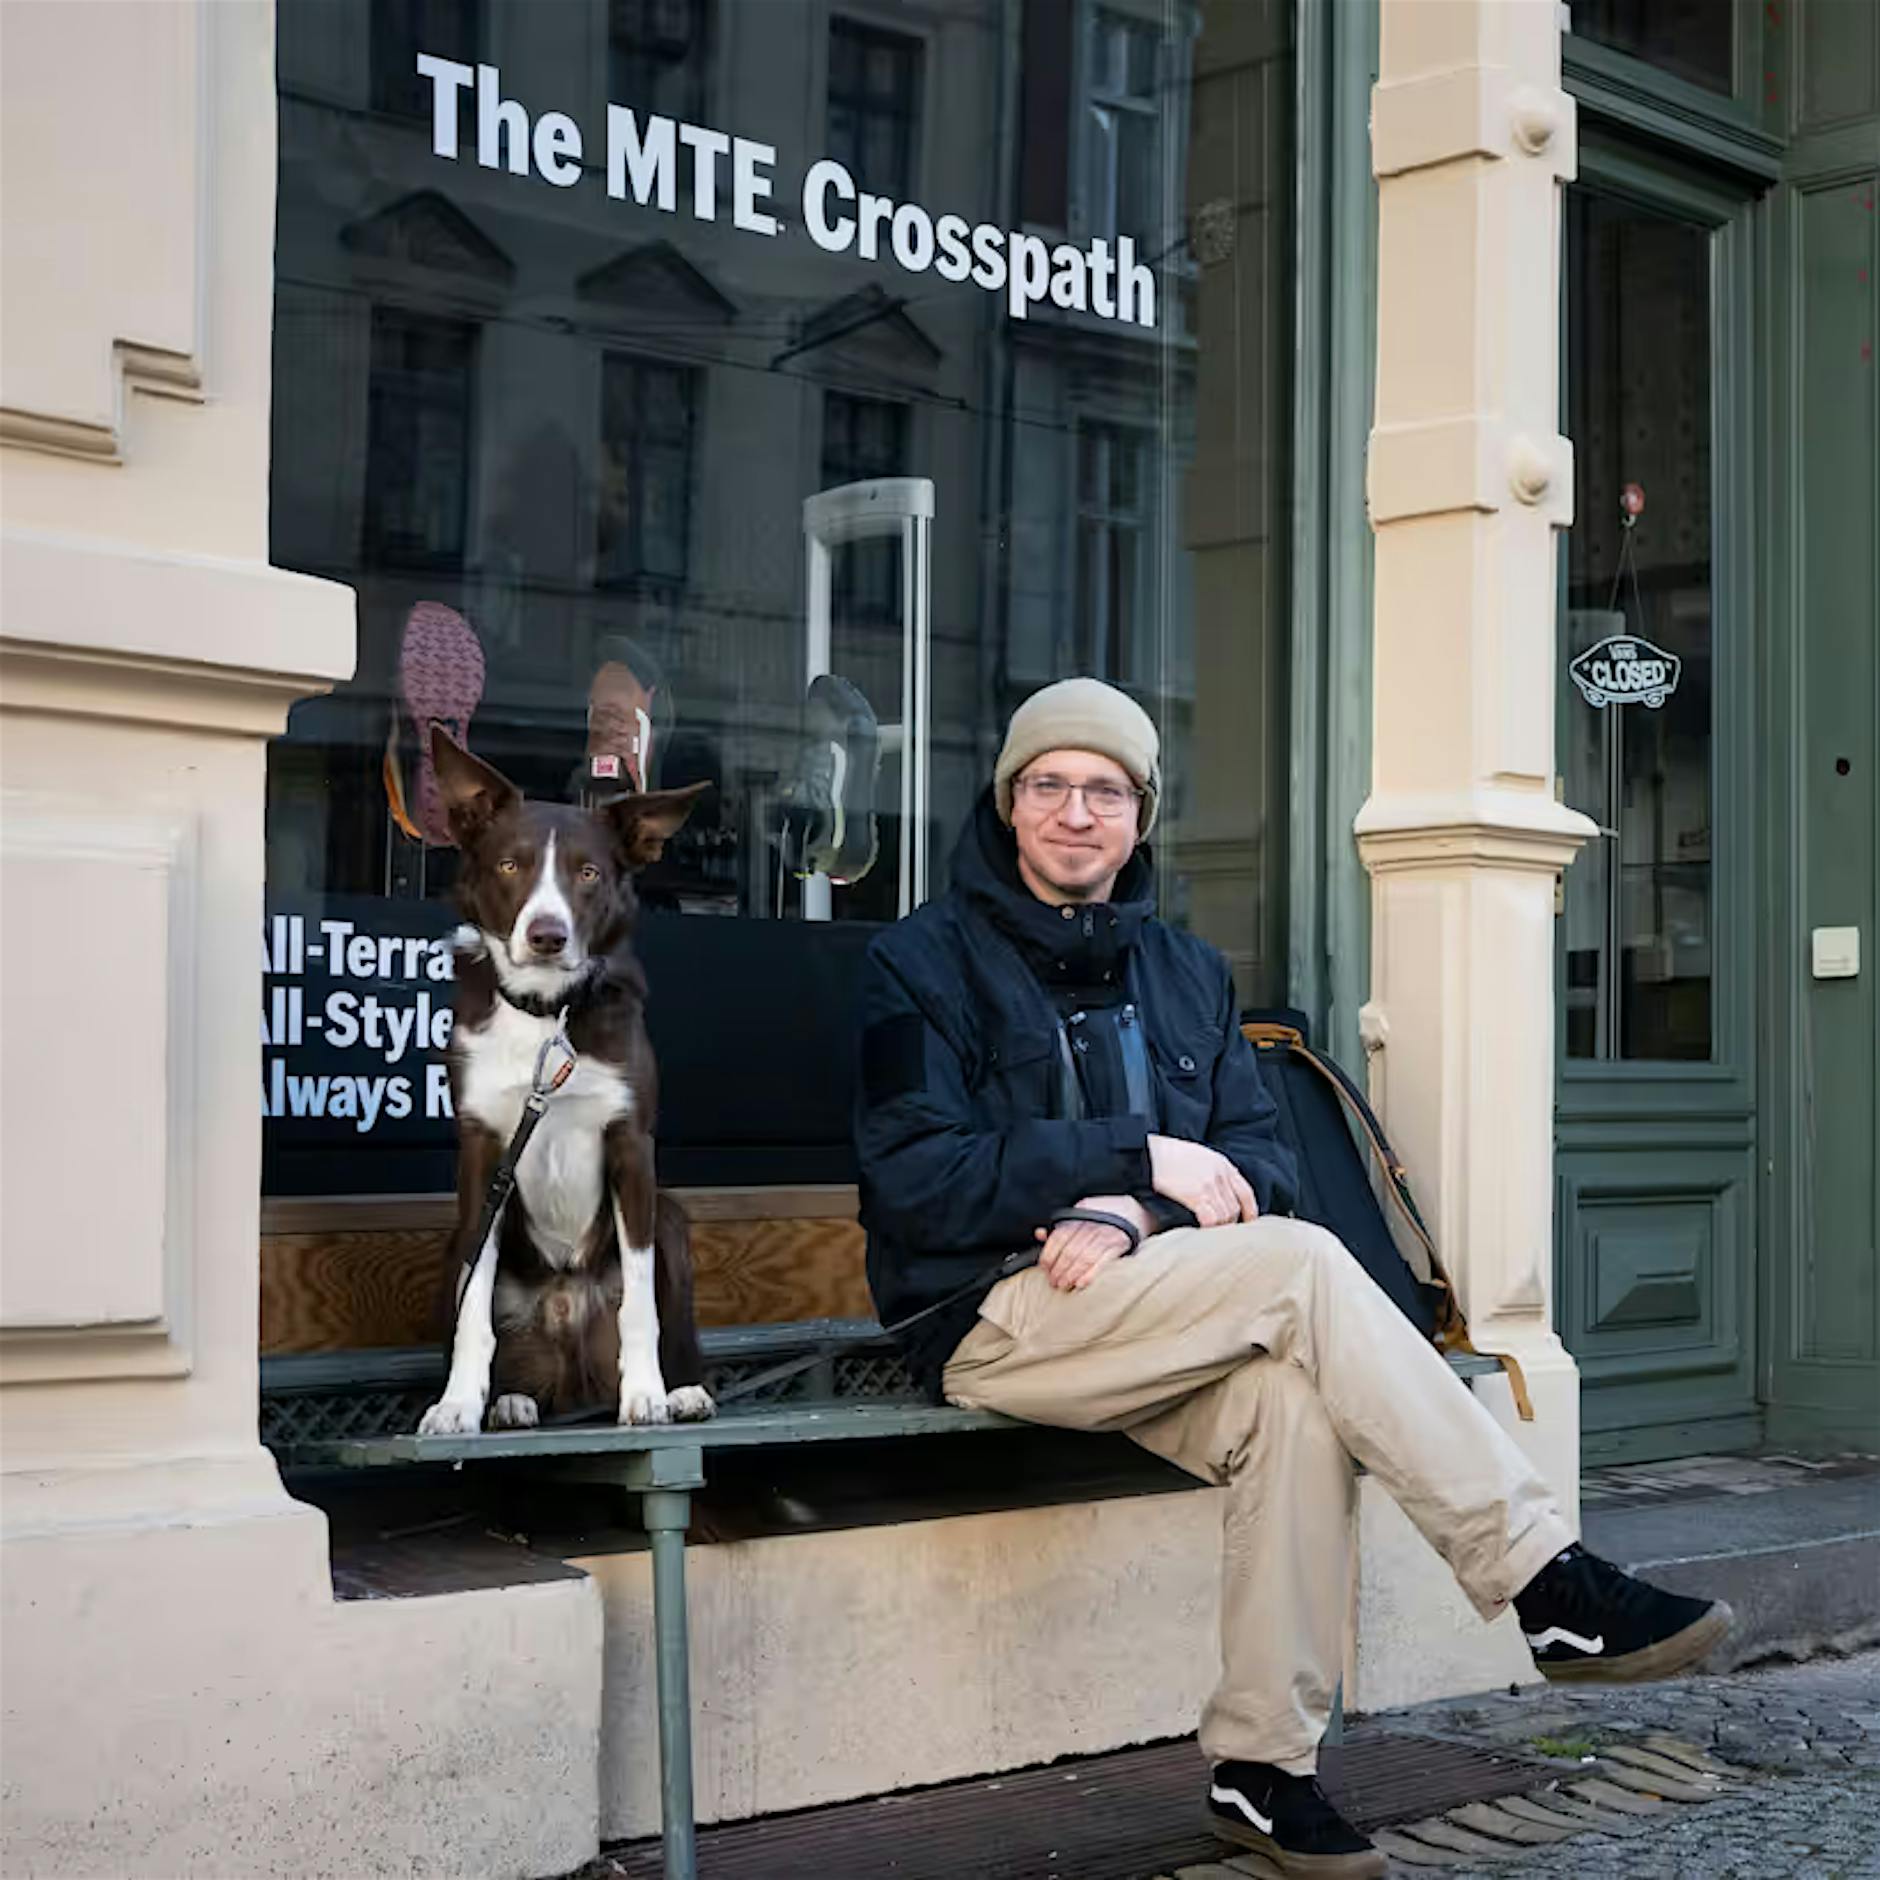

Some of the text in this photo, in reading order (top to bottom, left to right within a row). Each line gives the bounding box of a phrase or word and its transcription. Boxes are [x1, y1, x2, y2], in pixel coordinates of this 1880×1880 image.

[417, 53, 582, 187] The
[802, 159, 1156, 328] Crosspath
[1591, 660, 1666, 692] CLOSED
[261, 986, 454, 1064] ll-Style
[262, 1058, 412, 1133] lways
